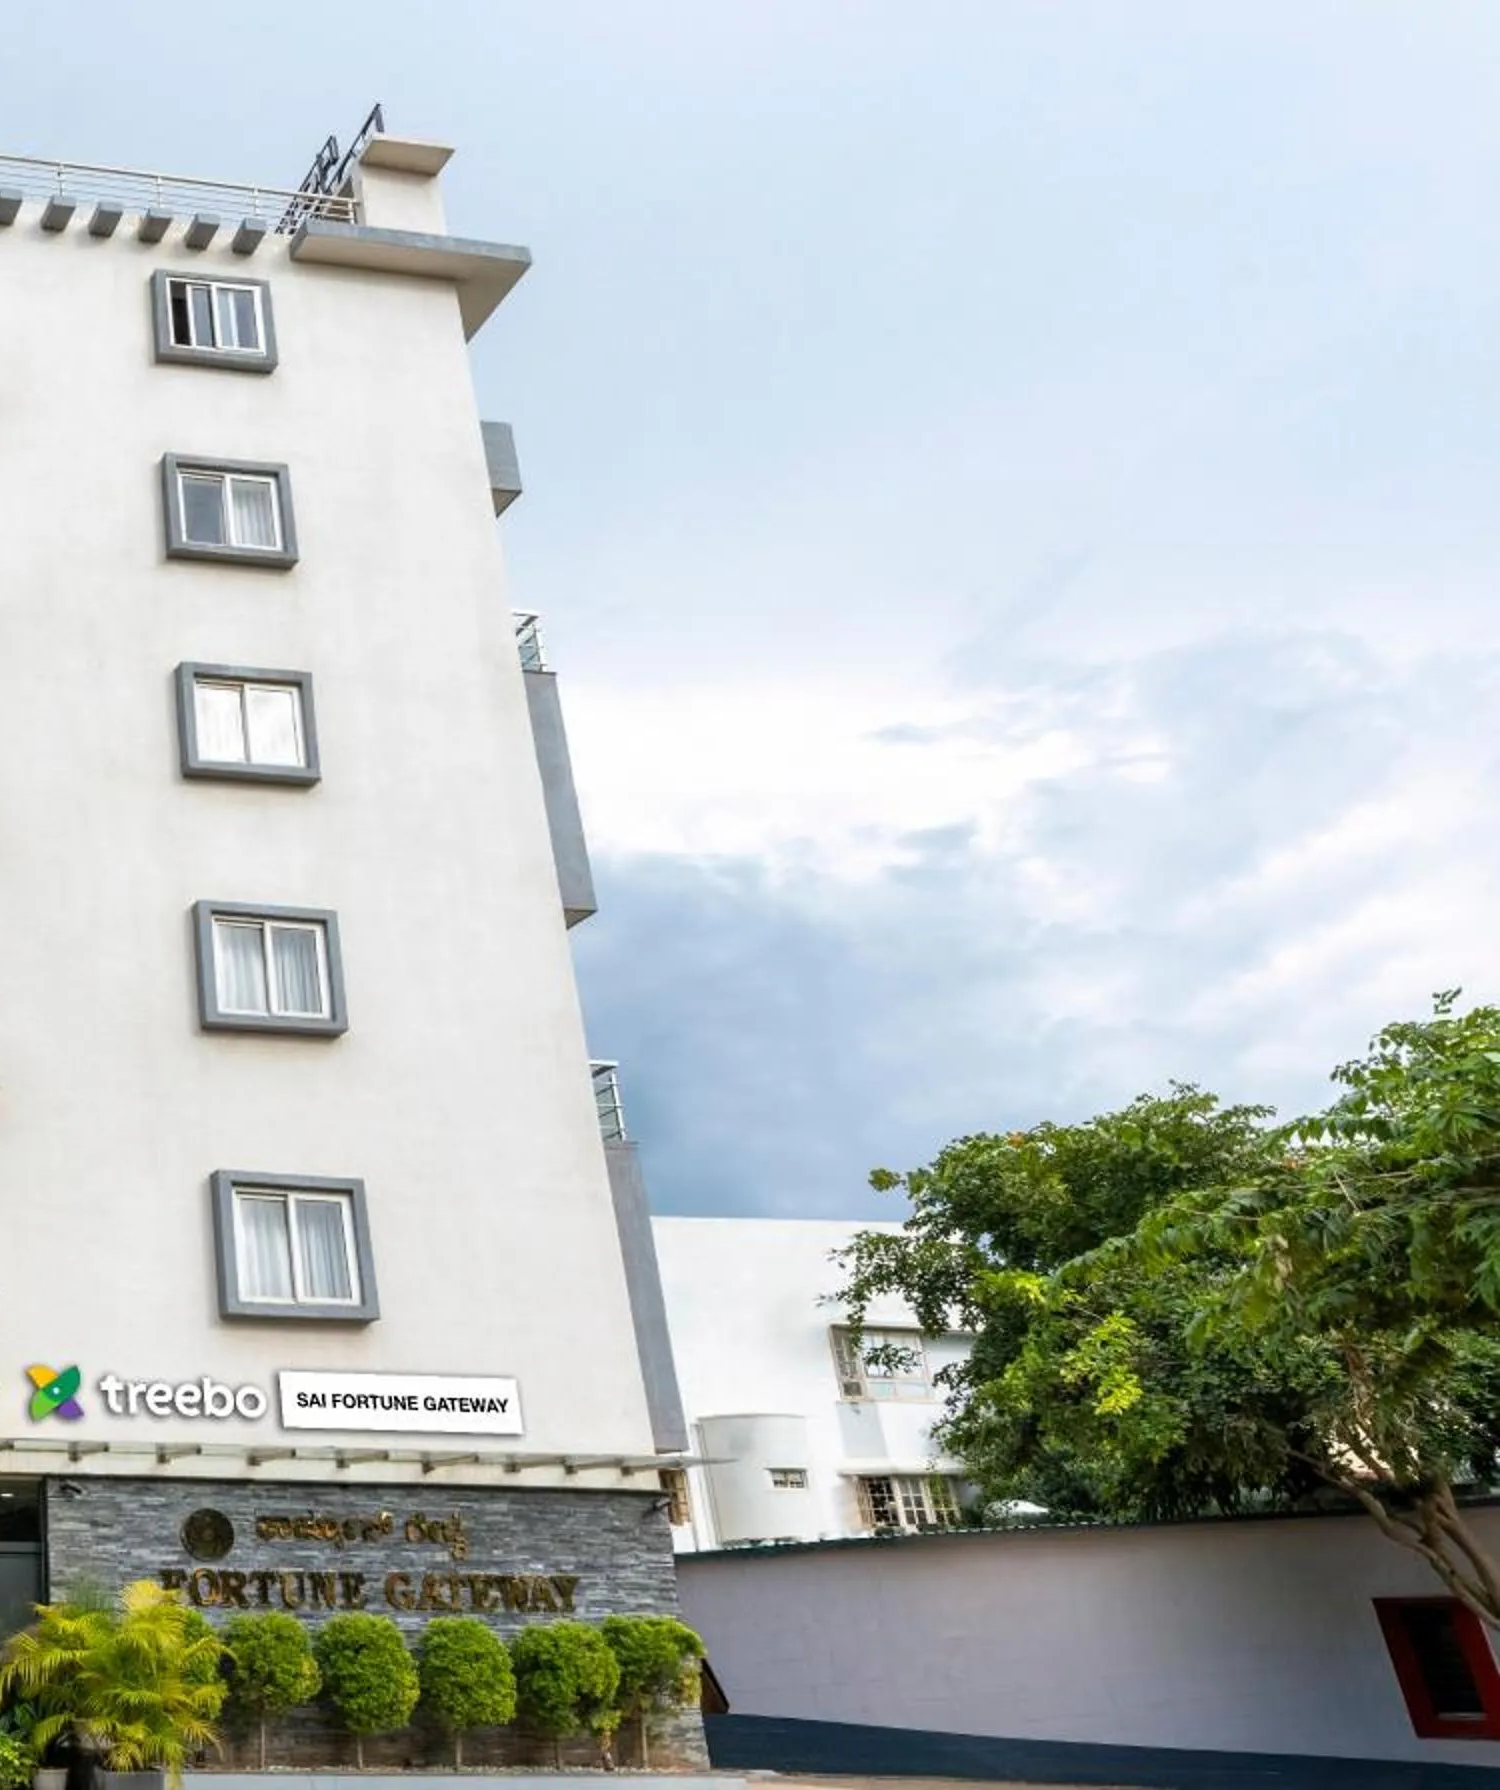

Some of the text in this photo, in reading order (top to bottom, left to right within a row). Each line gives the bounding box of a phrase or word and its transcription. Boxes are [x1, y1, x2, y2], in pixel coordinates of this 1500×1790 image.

[100, 1375, 267, 1419] treebo
[297, 1392, 509, 1413] SAI FORTUNE GATEWAY
[383, 1571, 580, 1613] GATEWAY
